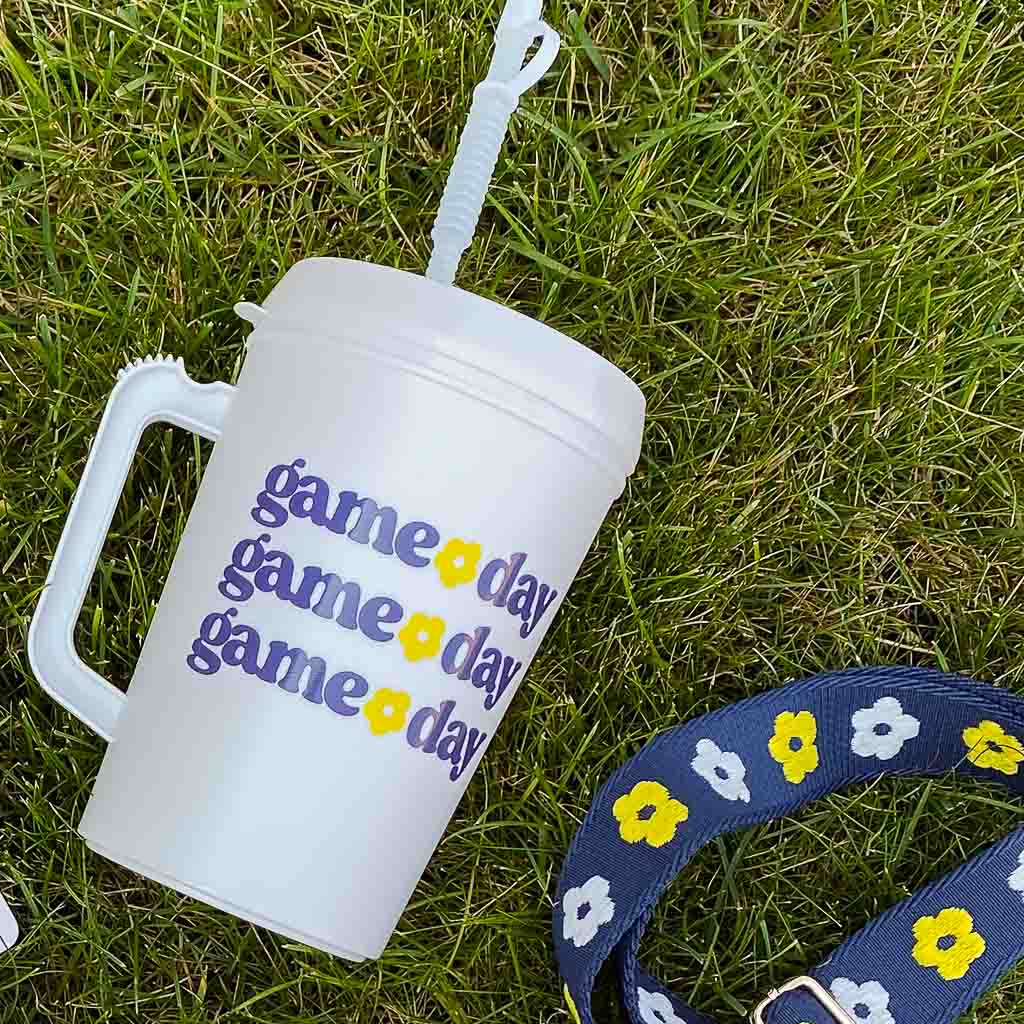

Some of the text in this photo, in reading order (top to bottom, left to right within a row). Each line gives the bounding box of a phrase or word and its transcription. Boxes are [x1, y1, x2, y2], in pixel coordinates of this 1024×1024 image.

[218, 533, 522, 710] game day
[251, 458, 558, 639] game day
[186, 607, 487, 782] game day
